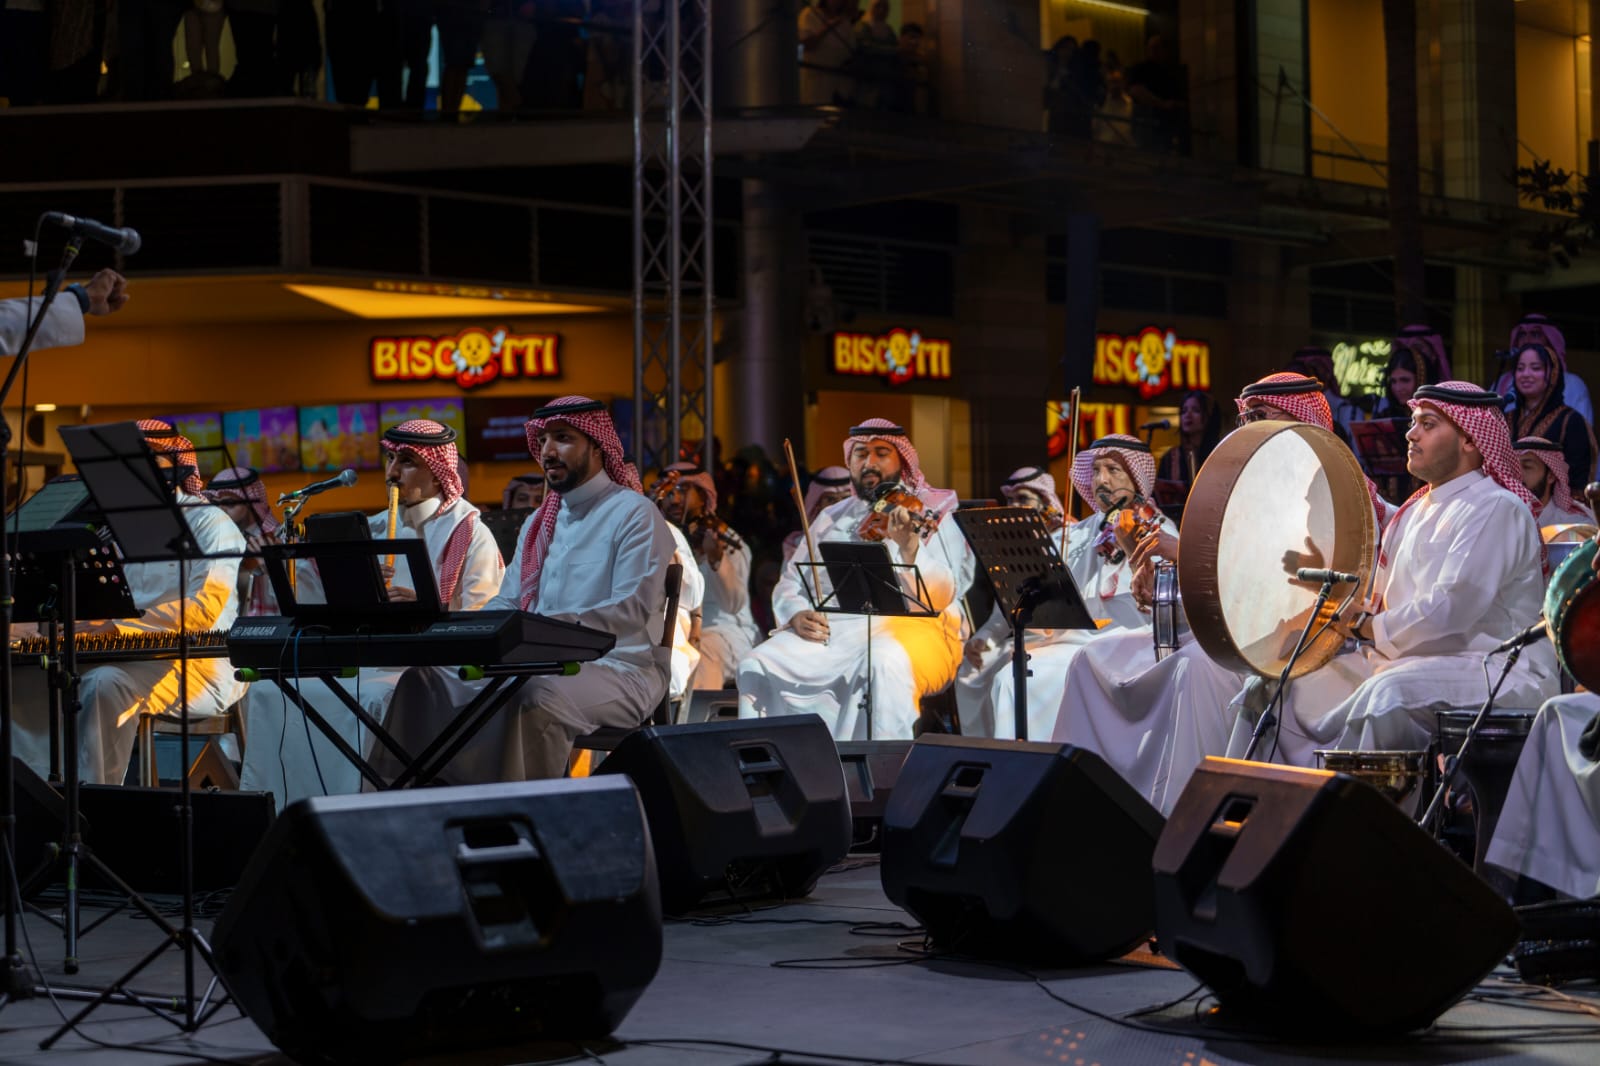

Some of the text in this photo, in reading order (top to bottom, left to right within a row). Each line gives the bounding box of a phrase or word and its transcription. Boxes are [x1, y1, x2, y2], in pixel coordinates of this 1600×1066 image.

[374, 331, 555, 378] BISCOTTI
[834, 332, 951, 376] BISCOTTI
[1093, 333, 1210, 386] ISCOTTI
